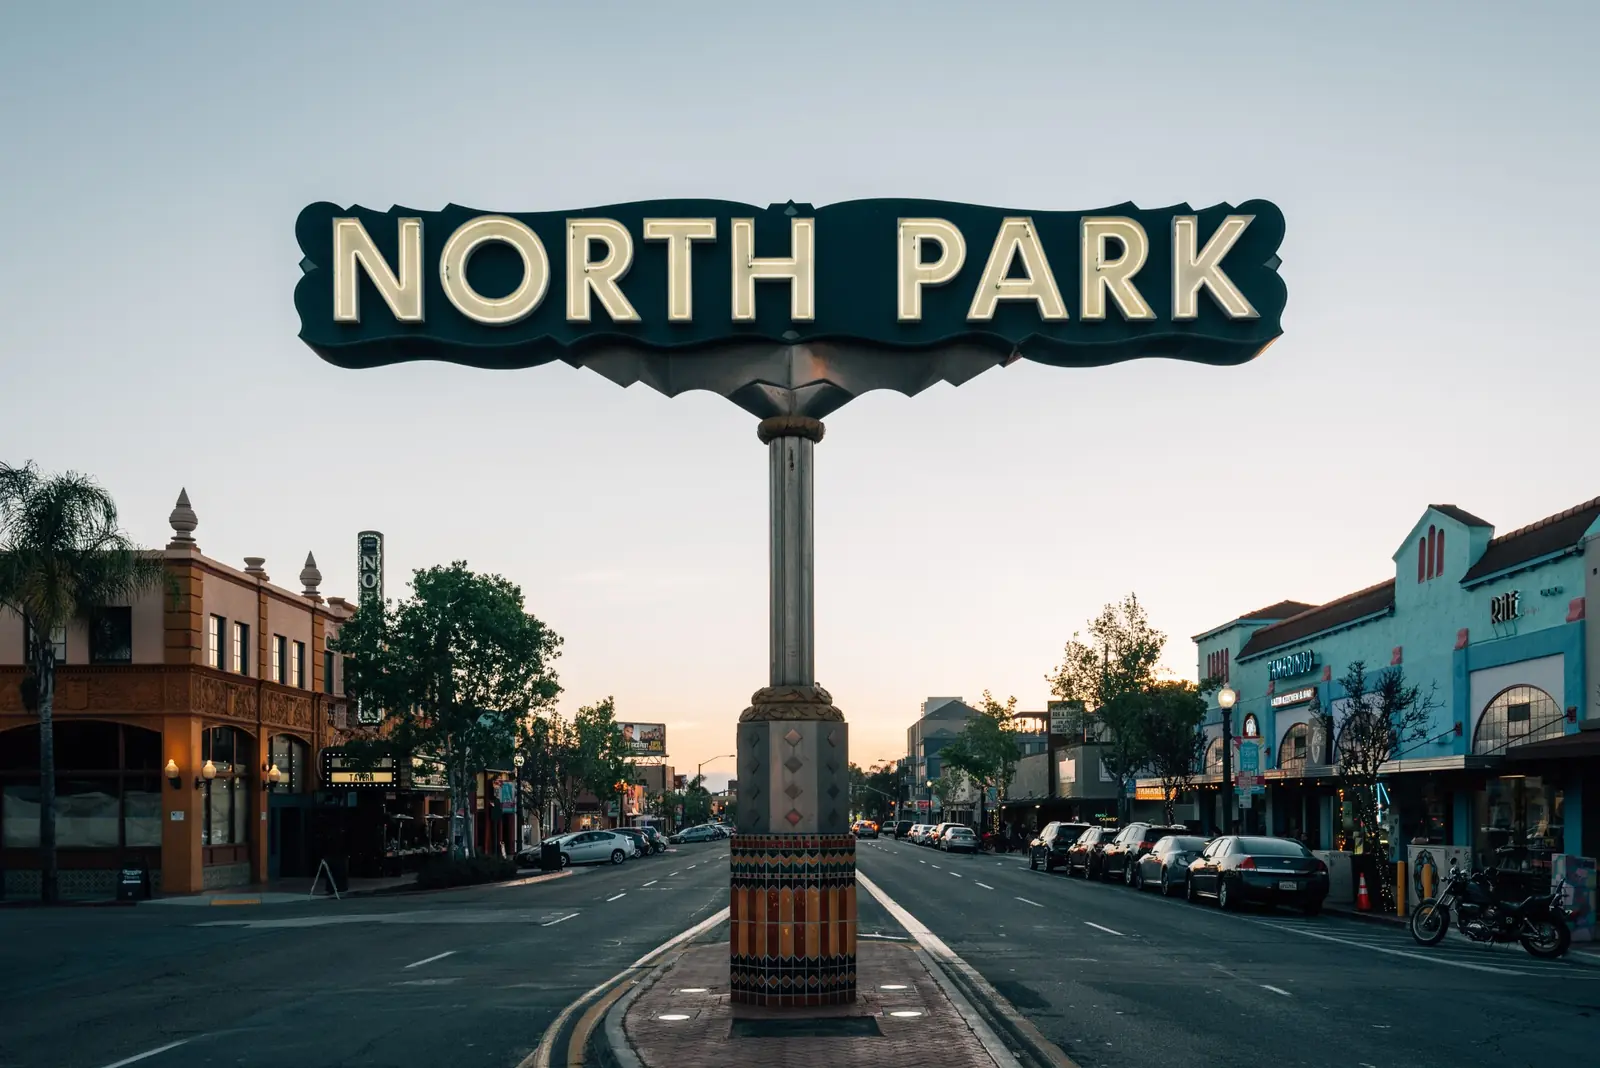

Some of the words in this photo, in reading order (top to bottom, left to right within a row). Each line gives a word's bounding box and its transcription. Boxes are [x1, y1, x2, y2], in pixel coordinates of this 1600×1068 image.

[332, 214, 815, 324] NORTH
[897, 214, 1261, 322] PARK
[349, 773, 374, 782] TAVERN
